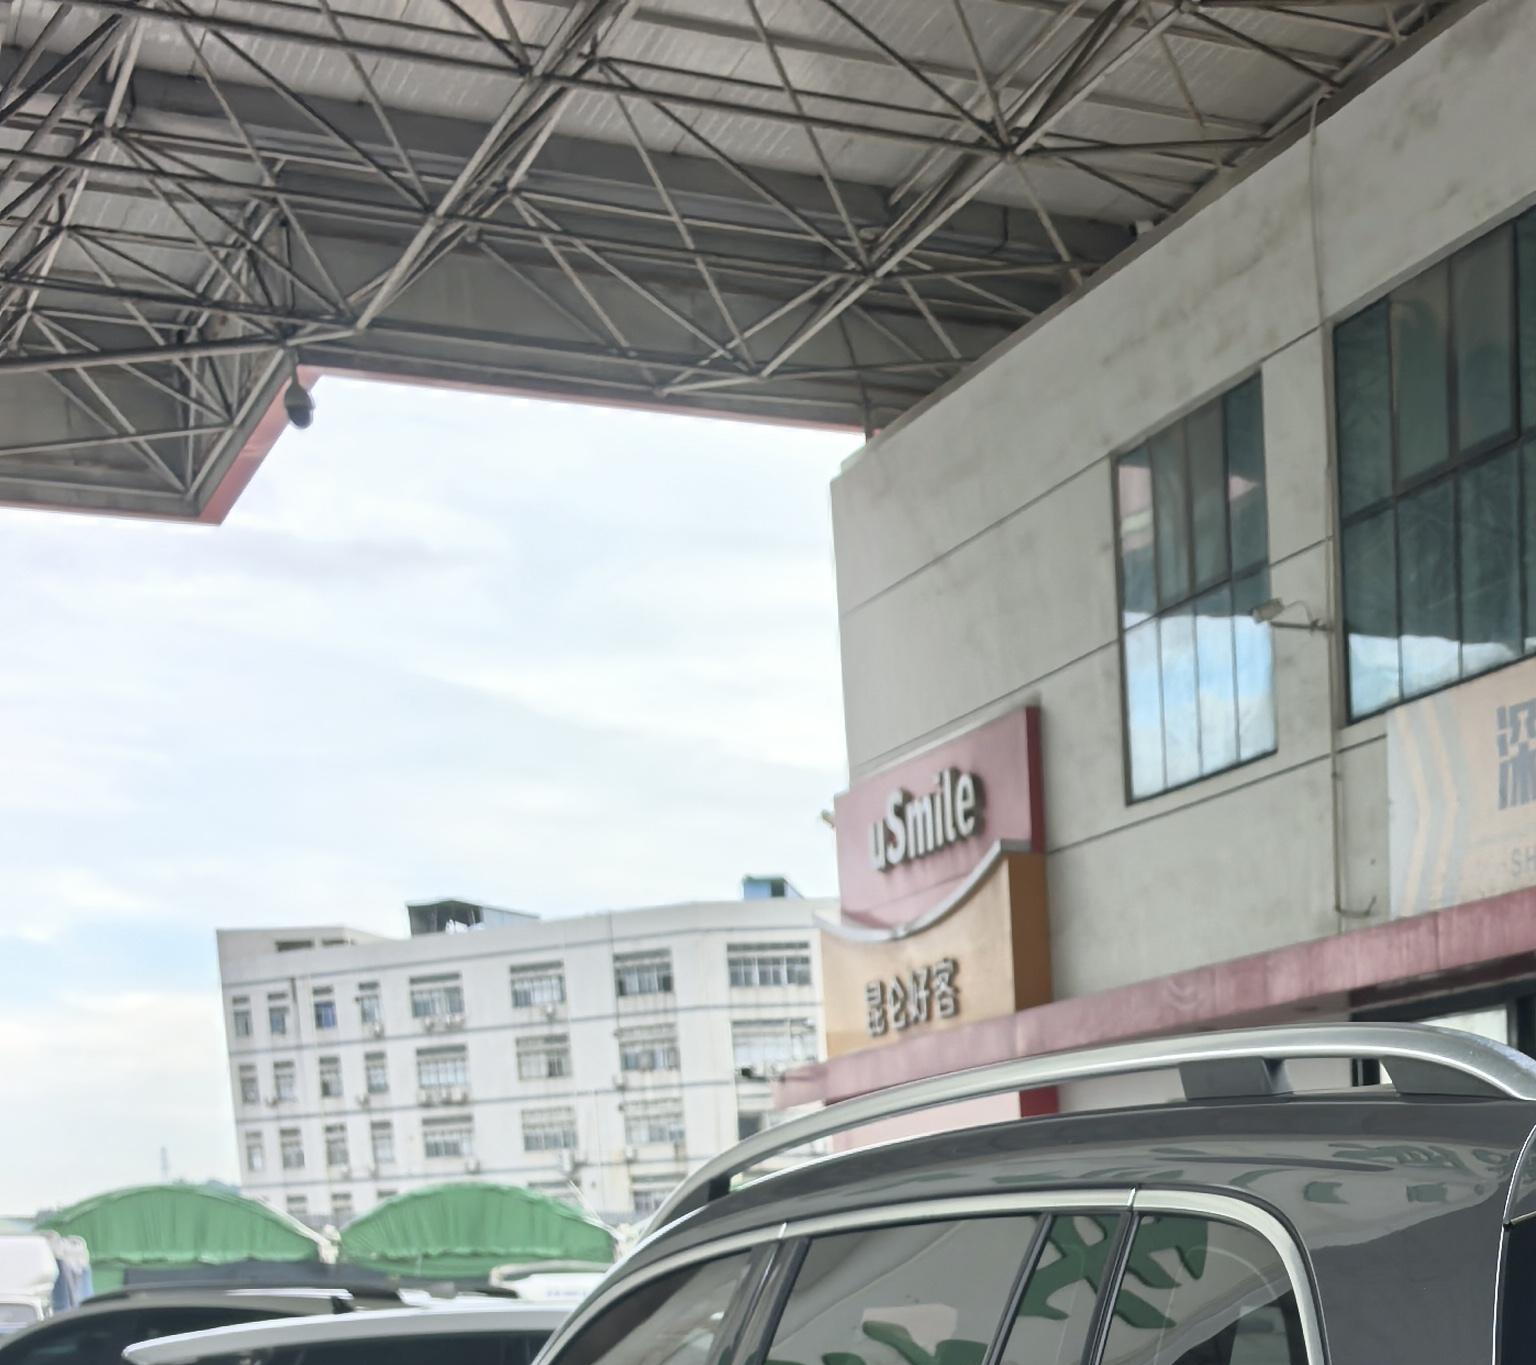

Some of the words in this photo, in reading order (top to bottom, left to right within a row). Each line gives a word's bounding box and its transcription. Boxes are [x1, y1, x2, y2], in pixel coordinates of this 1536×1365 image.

[869, 769, 977, 869] uSmile
[865, 958, 960, 1037] 昆仑好客
